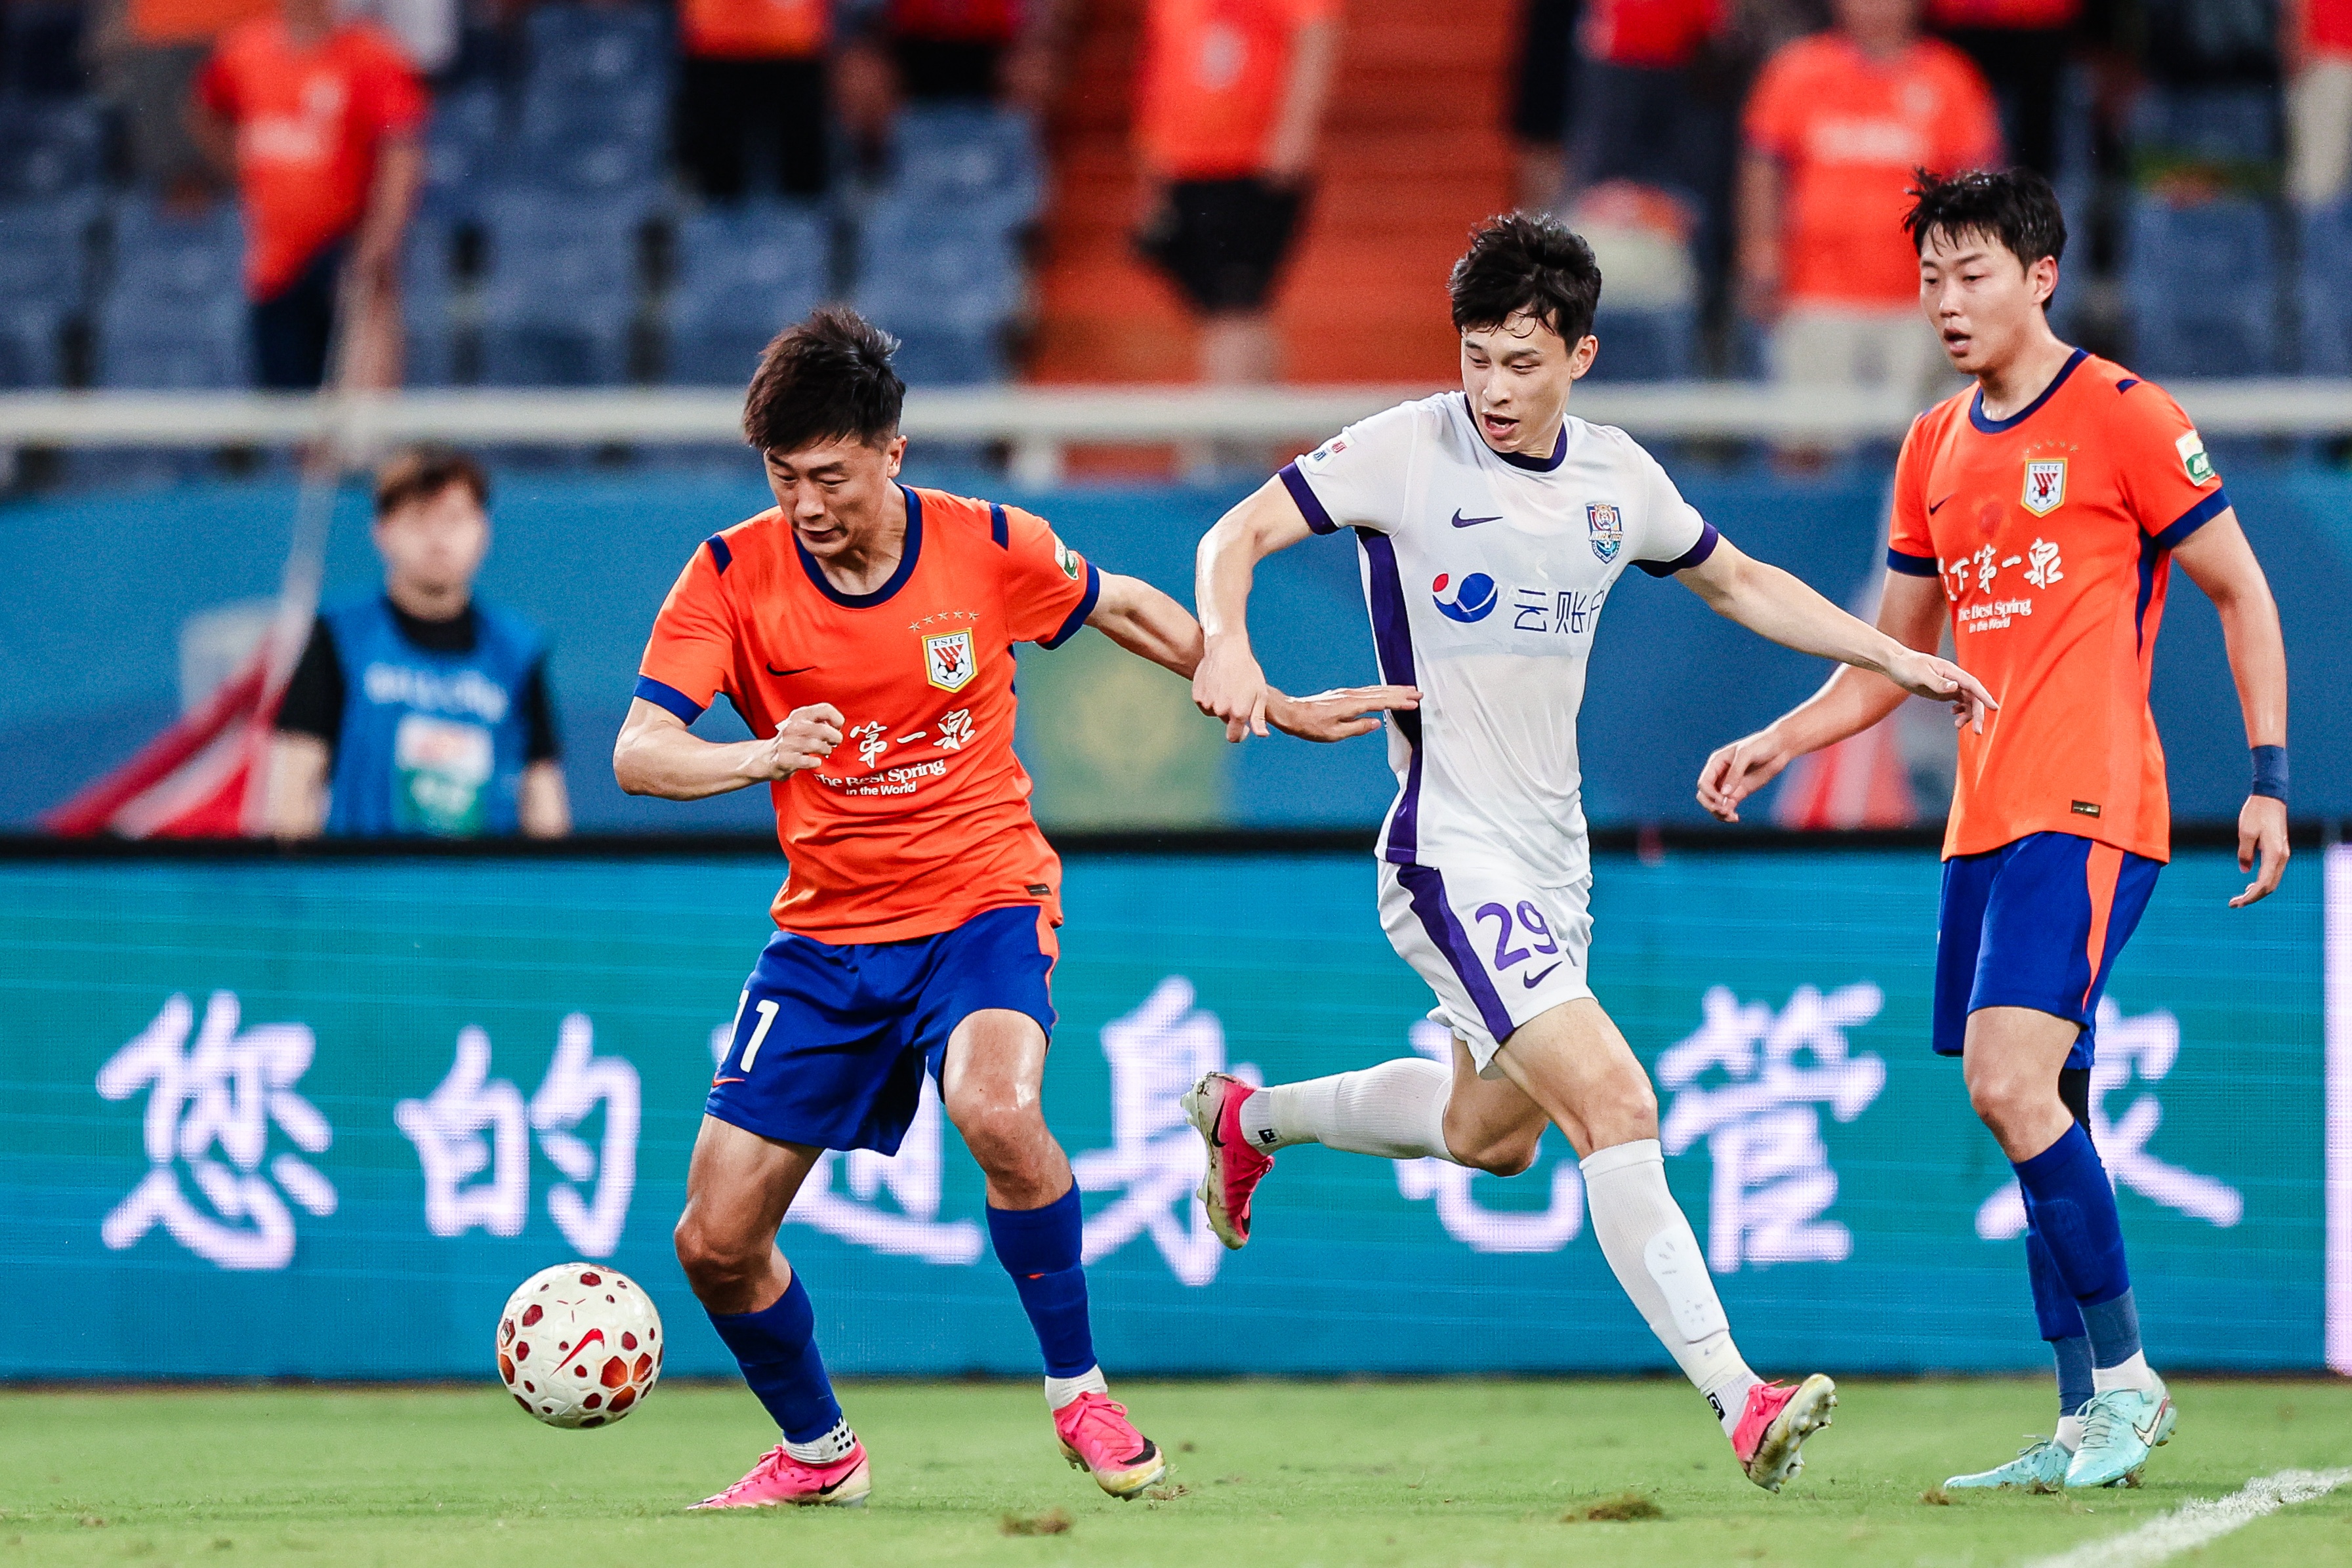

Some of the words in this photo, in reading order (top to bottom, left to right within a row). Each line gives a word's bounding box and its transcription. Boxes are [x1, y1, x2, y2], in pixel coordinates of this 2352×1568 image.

[1971, 604, 1993, 619] Best
[1994, 598, 2032, 617] Spring
[1988, 616, 2012, 630] World
[931, 635, 964, 647] TSFC
[825, 708, 976, 768] 第一泉
[888, 759, 947, 783] Spring
[859, 786, 878, 796] the
[880, 781, 917, 796] World
[1475, 900, 1559, 971] 29
